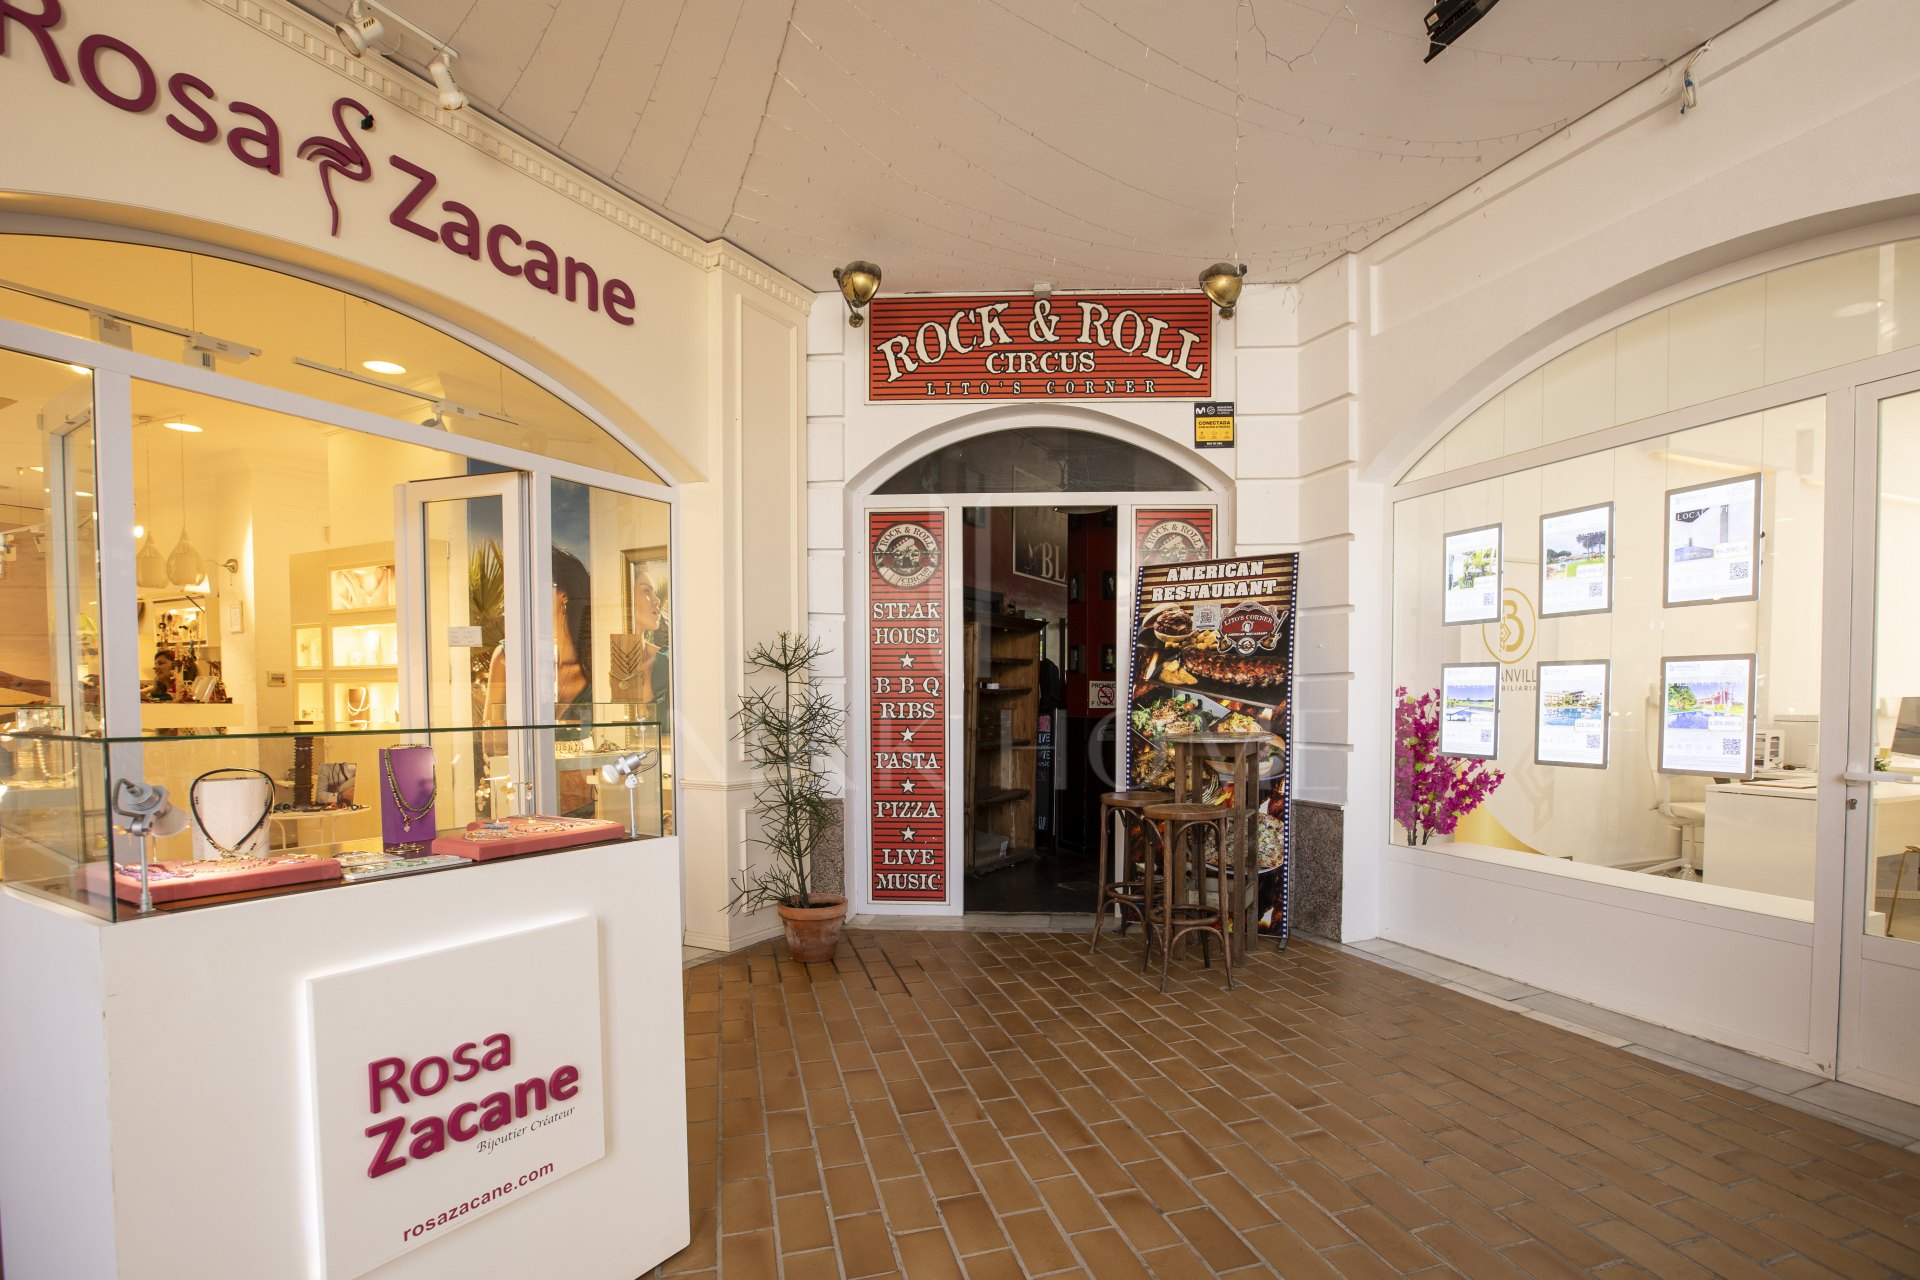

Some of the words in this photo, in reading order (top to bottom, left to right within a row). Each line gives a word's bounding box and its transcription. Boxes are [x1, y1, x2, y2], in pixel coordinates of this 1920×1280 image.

[388, 154, 638, 326] Zacane
[876, 301, 1013, 383] ROCK
[1028, 298, 1060, 343] &
[1076, 300, 1205, 380] ROLL
[985, 350, 1097, 374] CIRCUS
[926, 380, 1022, 396] LITO'S
[1046, 379, 1157, 395] CORNER
[1166, 561, 1264, 582] AMERICAN
[1151, 579, 1278, 602] RESTAURANT
[873, 602, 941, 620] STEAK
[873, 627, 940, 645] HOUSE
[879, 701, 935, 719] RIBS
[874, 752, 941, 769] PASTA
[874, 801, 942, 819] PIZZA
[881, 848, 935, 866] LIVE
[876, 873, 942, 890] MUSIC
[366, 1032, 511, 1115] Rosa
[364, 1062, 580, 1179] Zacane
[476, 1121, 529, 1155] Bijoutier
[530, 1103, 576, 1135] Créateur
[402, 1159, 556, 1243] rosazacane.com
